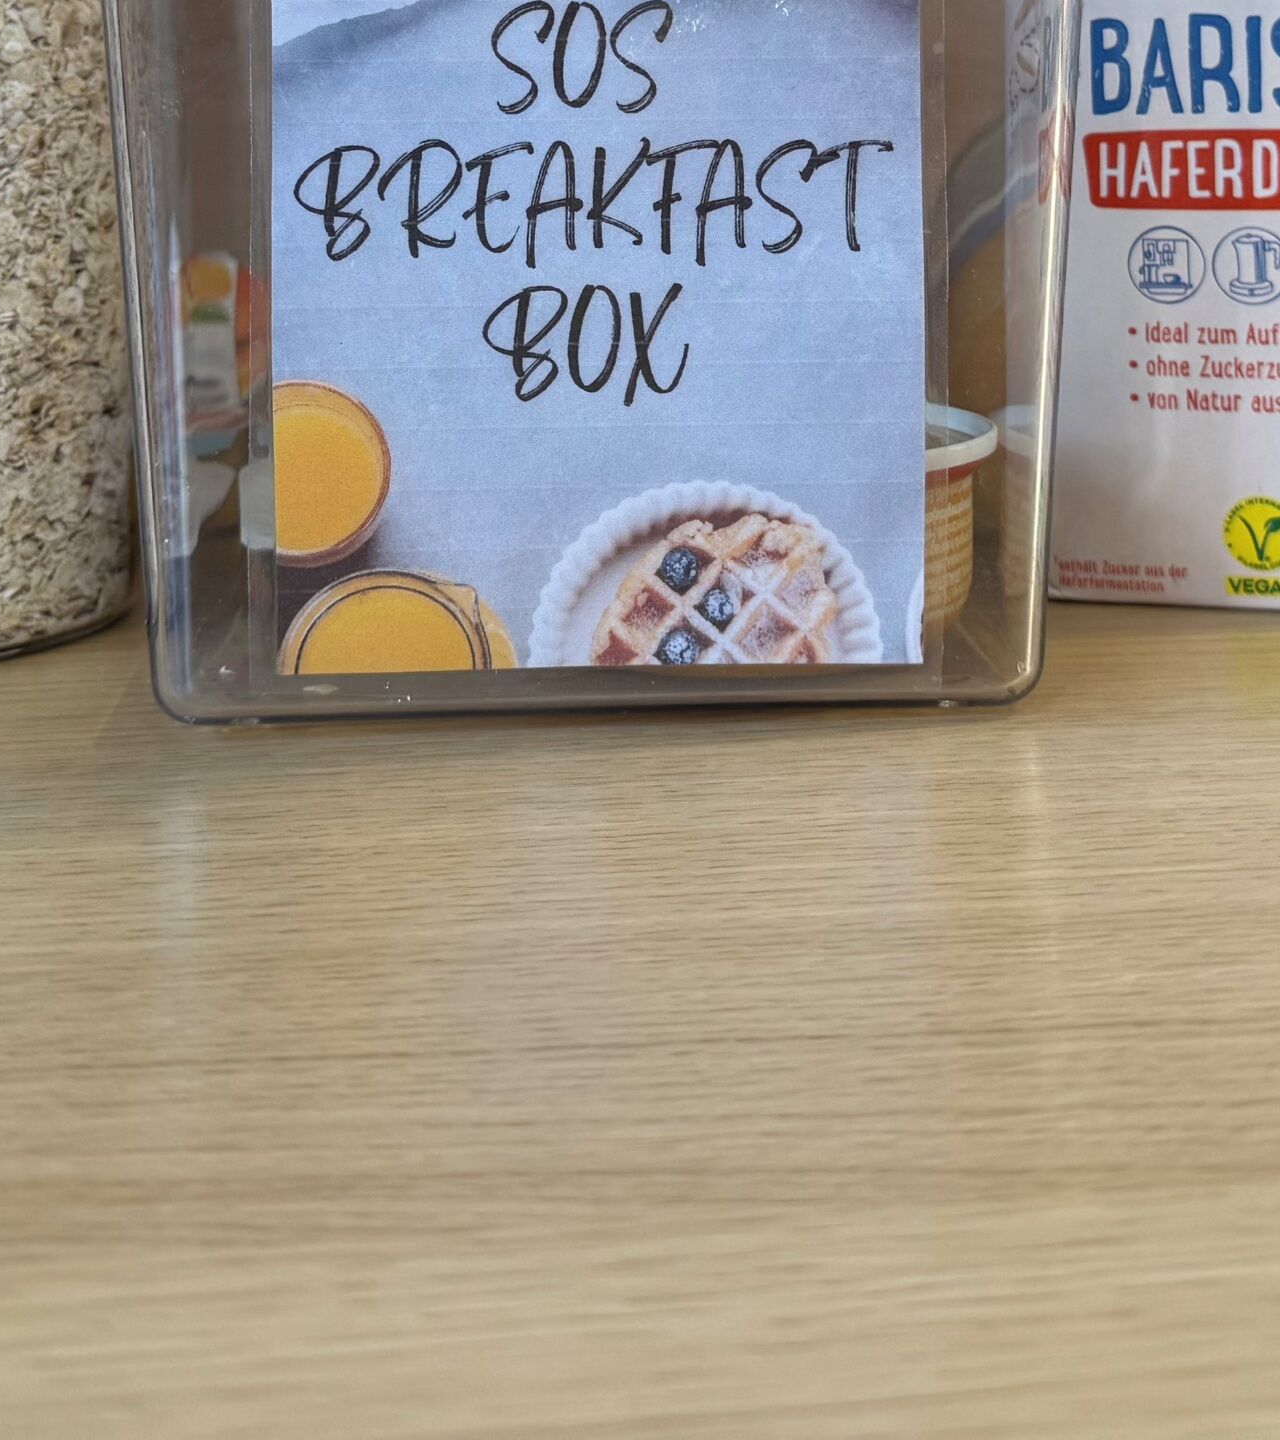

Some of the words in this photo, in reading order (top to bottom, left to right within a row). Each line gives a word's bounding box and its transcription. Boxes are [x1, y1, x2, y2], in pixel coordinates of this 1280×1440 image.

[491, 0, 673, 114] SOS
[293, 137, 894, 268] BREAKFAST
[482, 282, 690, 407] BOX
[1197, 327, 1237, 345] zum
[1146, 355, 1190, 377] ohne
[1147, 391, 1178, 409] von
[1186, 389, 1242, 412] Natur
[1102, 559, 1140, 576] Zucker
[1145, 564, 1164, 577] aus
